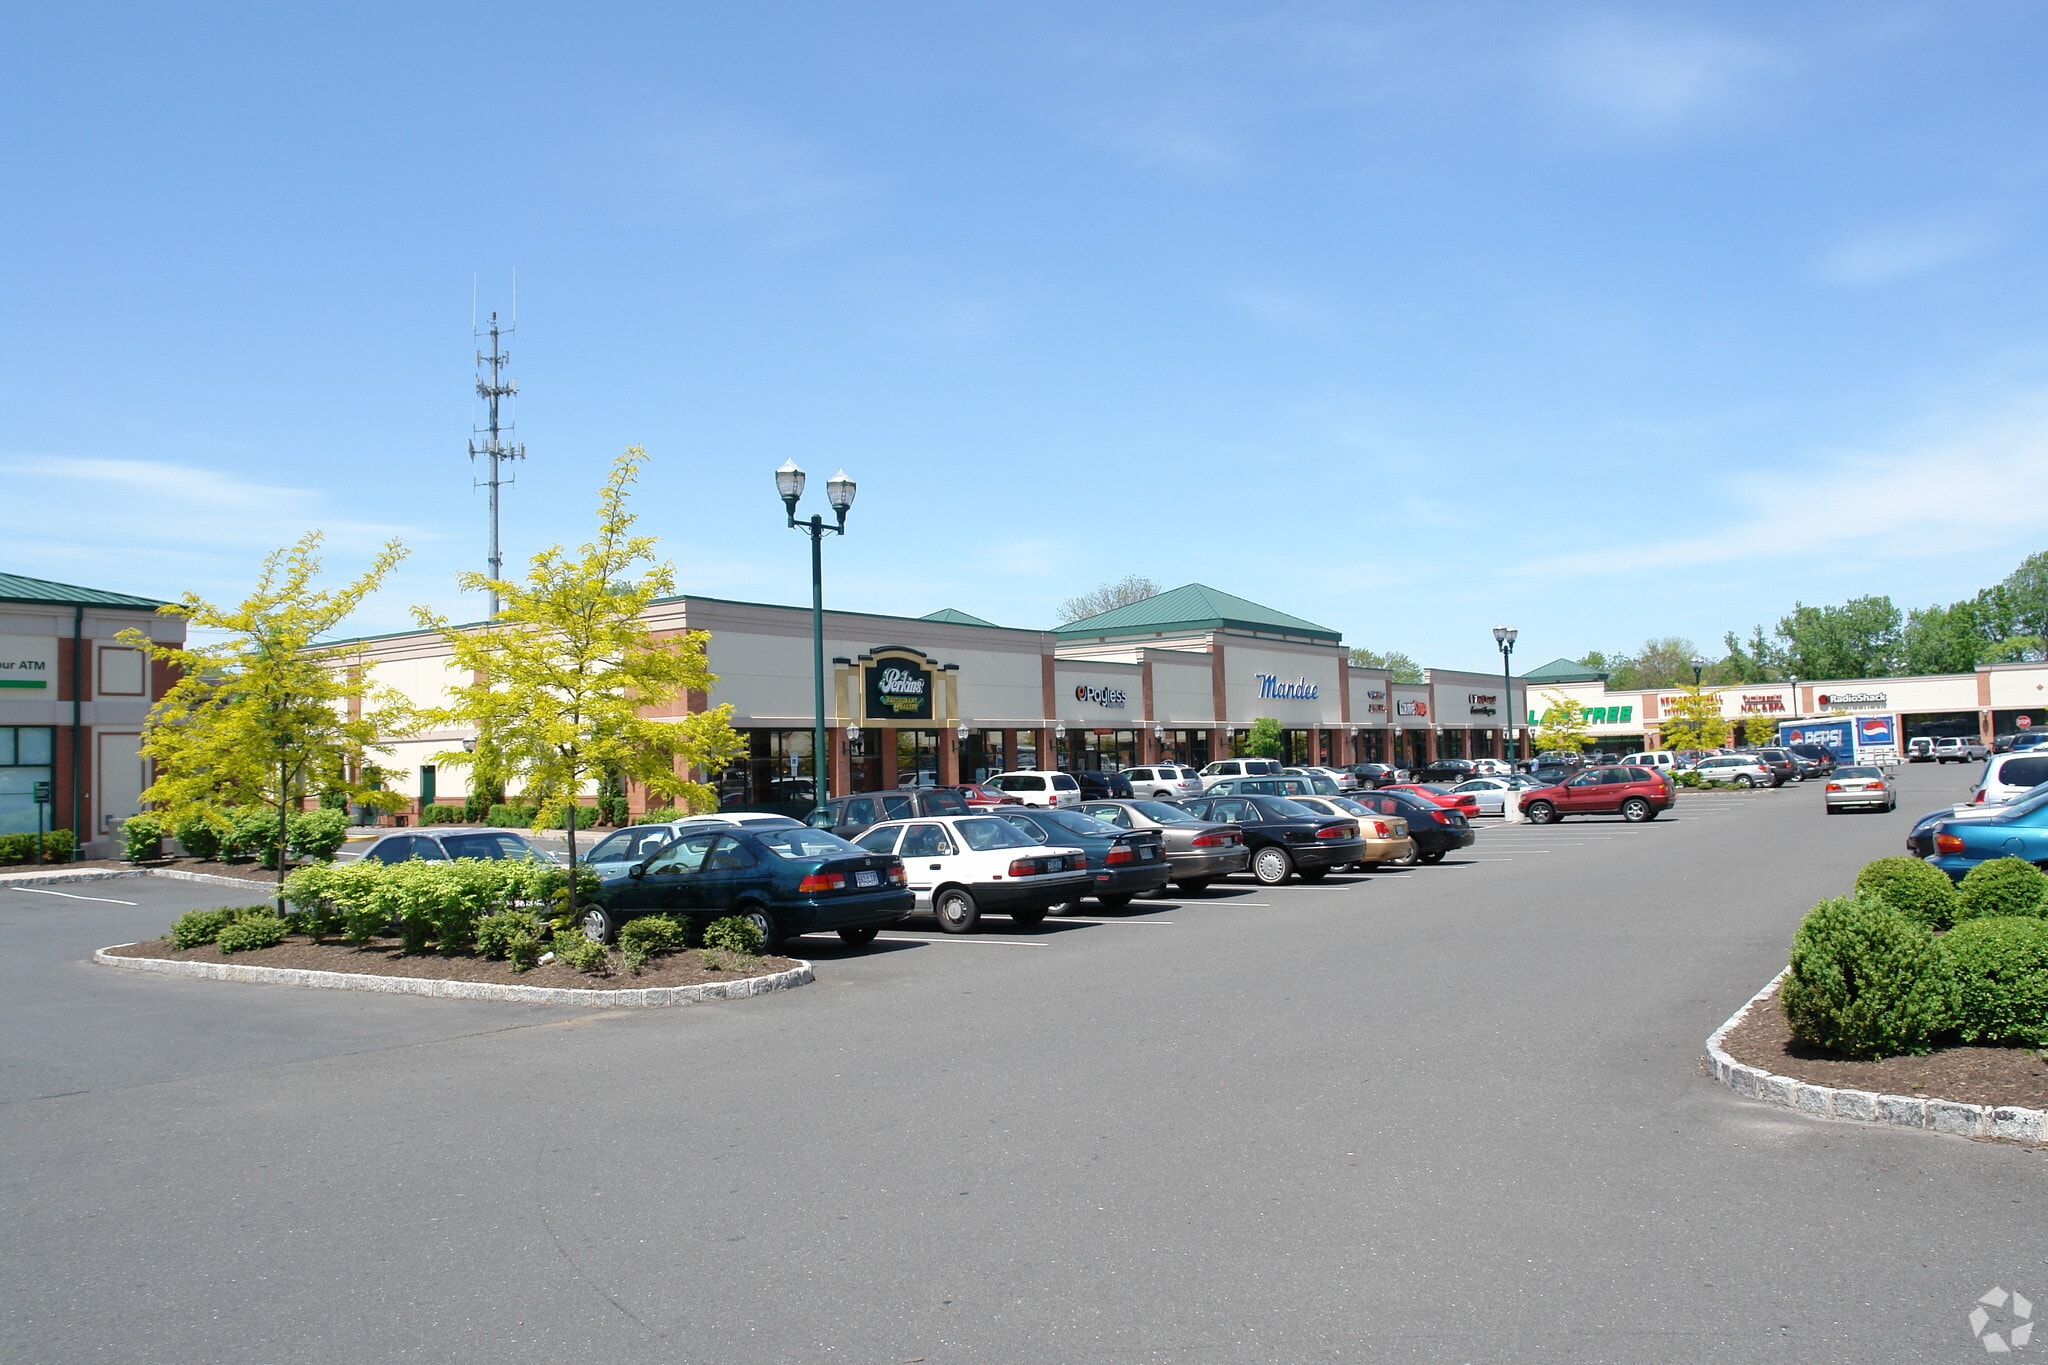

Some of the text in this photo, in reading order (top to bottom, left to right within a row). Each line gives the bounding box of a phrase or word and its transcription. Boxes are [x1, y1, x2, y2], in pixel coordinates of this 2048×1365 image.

[19, 660, 46, 670] ATM
[881, 668, 922, 693] Perkins
[1254, 674, 1319, 699] Mandee
[1087, 686, 1127, 706] Payless
[1829, 692, 1888, 704] RadioShack
[1580, 706, 1633, 724] TREE
[1804, 729, 1843, 747] PEPSI
